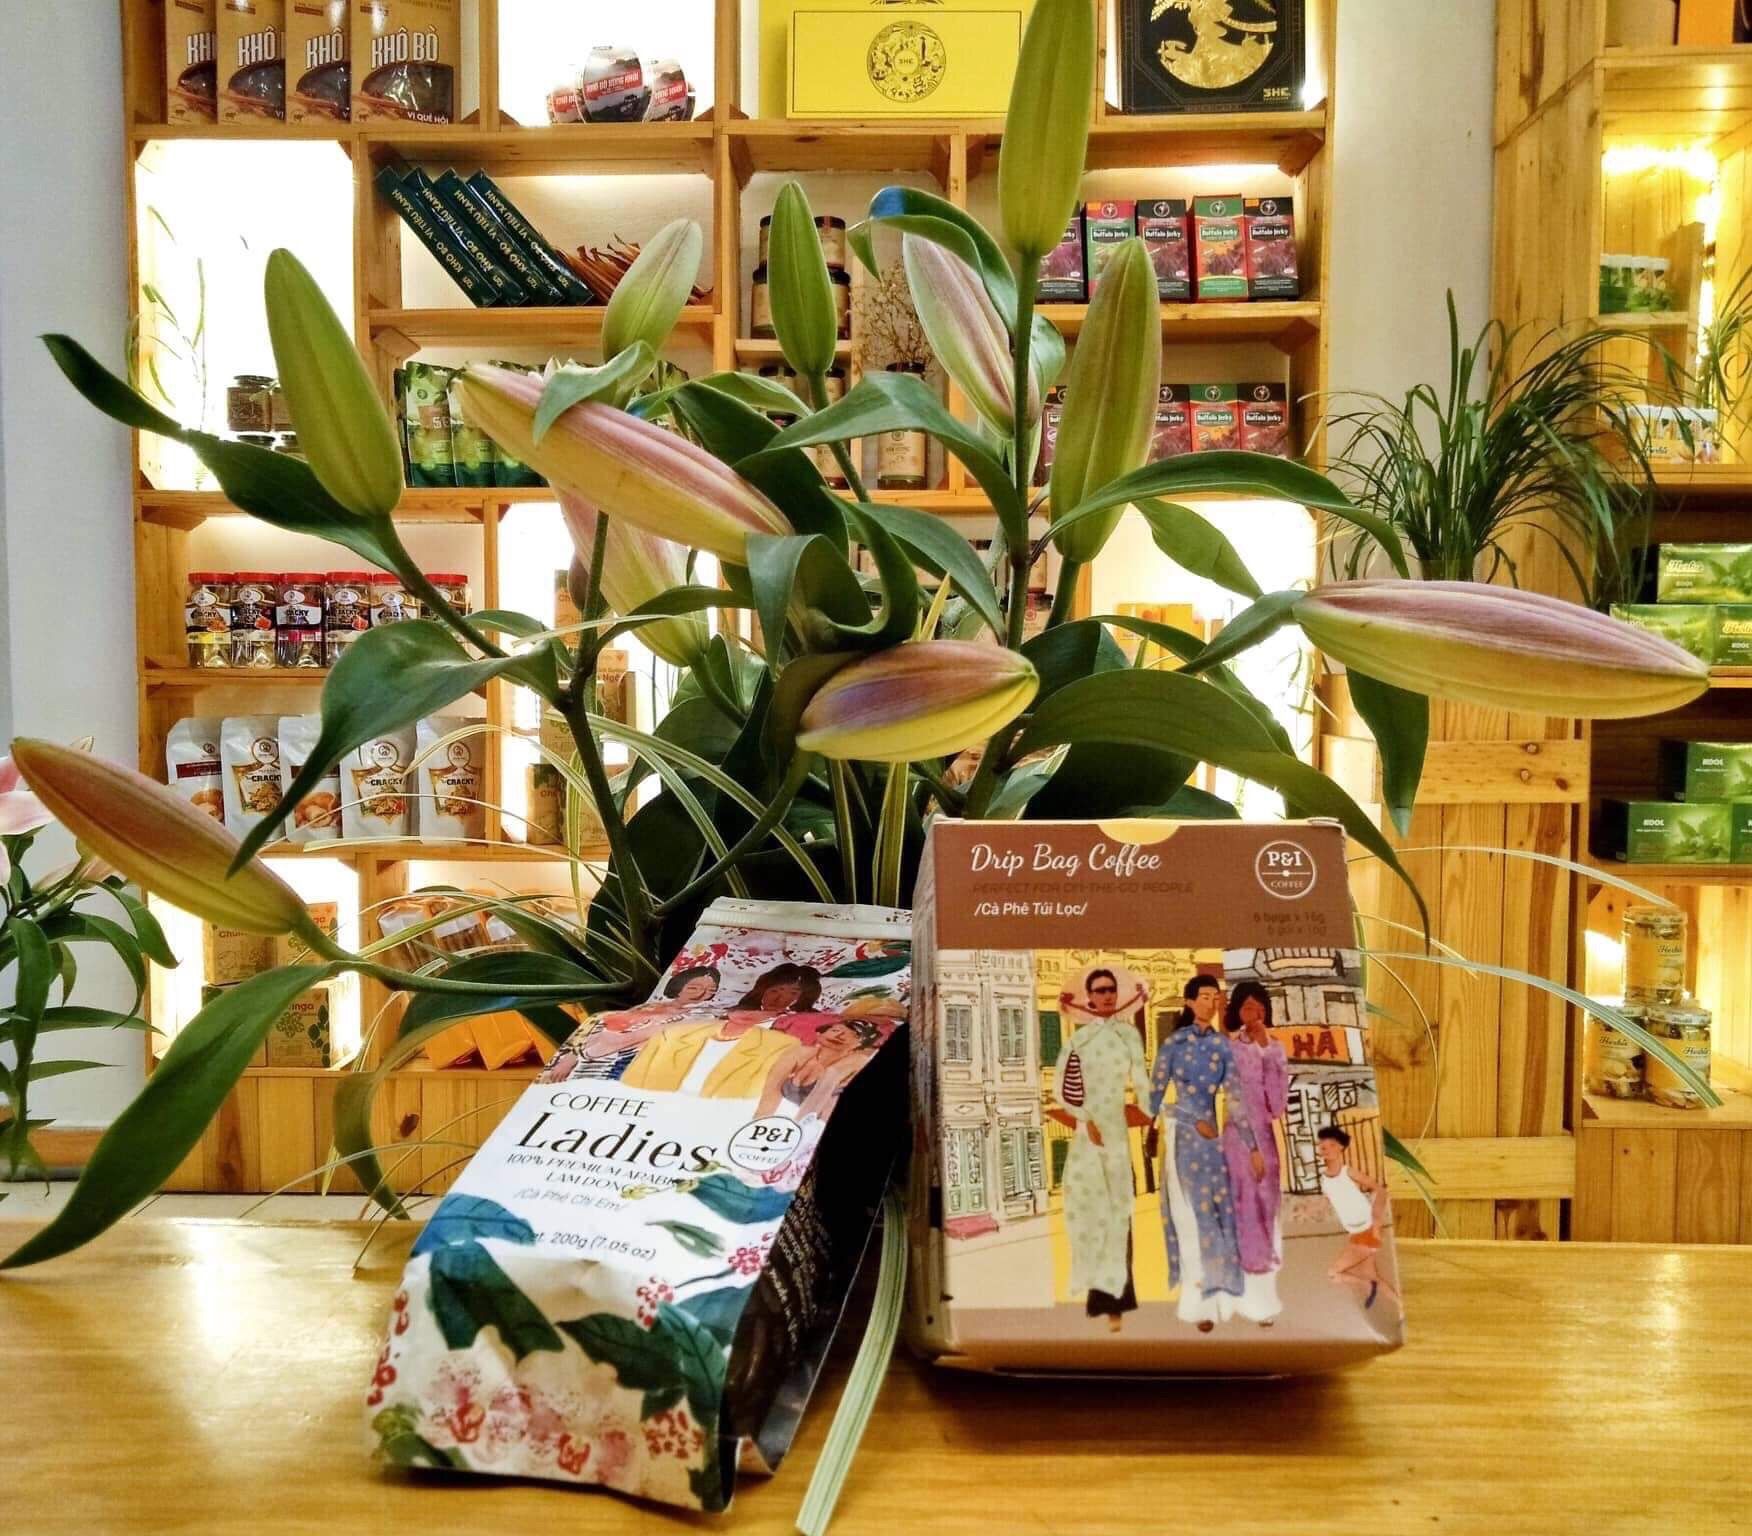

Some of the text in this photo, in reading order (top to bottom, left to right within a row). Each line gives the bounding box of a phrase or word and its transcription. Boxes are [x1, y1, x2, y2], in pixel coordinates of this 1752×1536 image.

[187, 32, 217, 65] KH
[371, 25, 438, 69] KHÔ BÒ
[391, 188, 414, 213] XANH
[453, 189, 476, 214] XANH
[484, 190, 507, 214] XANH
[971, 843, 1162, 877] Drip Bag Coffee
[1267, 851, 1302, 866] P&I
[972, 882, 1029, 894] PERFECT
[1031, 882, 1060, 894] FOR
[1142, 882, 1193, 894] PEOPLE
[974, 901, 1088, 917] /Cà Phê Túi Lọc/
[1292, 1030, 1338, 1058] HA
[550, 1092, 655, 1119] COFFEE
[515, 1111, 718, 1173] Ladies
[749, 1125, 793, 1143] P&I
[507, 1153, 544, 1167] 100%
[546, 1157, 622, 1178] PREMIUM
[738, 1151, 780, 1165] COFFEE
[551, 1231, 588, 1249] 200g
[591, 1235, 632, 1254] (7.05
[631, 1245, 656, 1261] oz)
